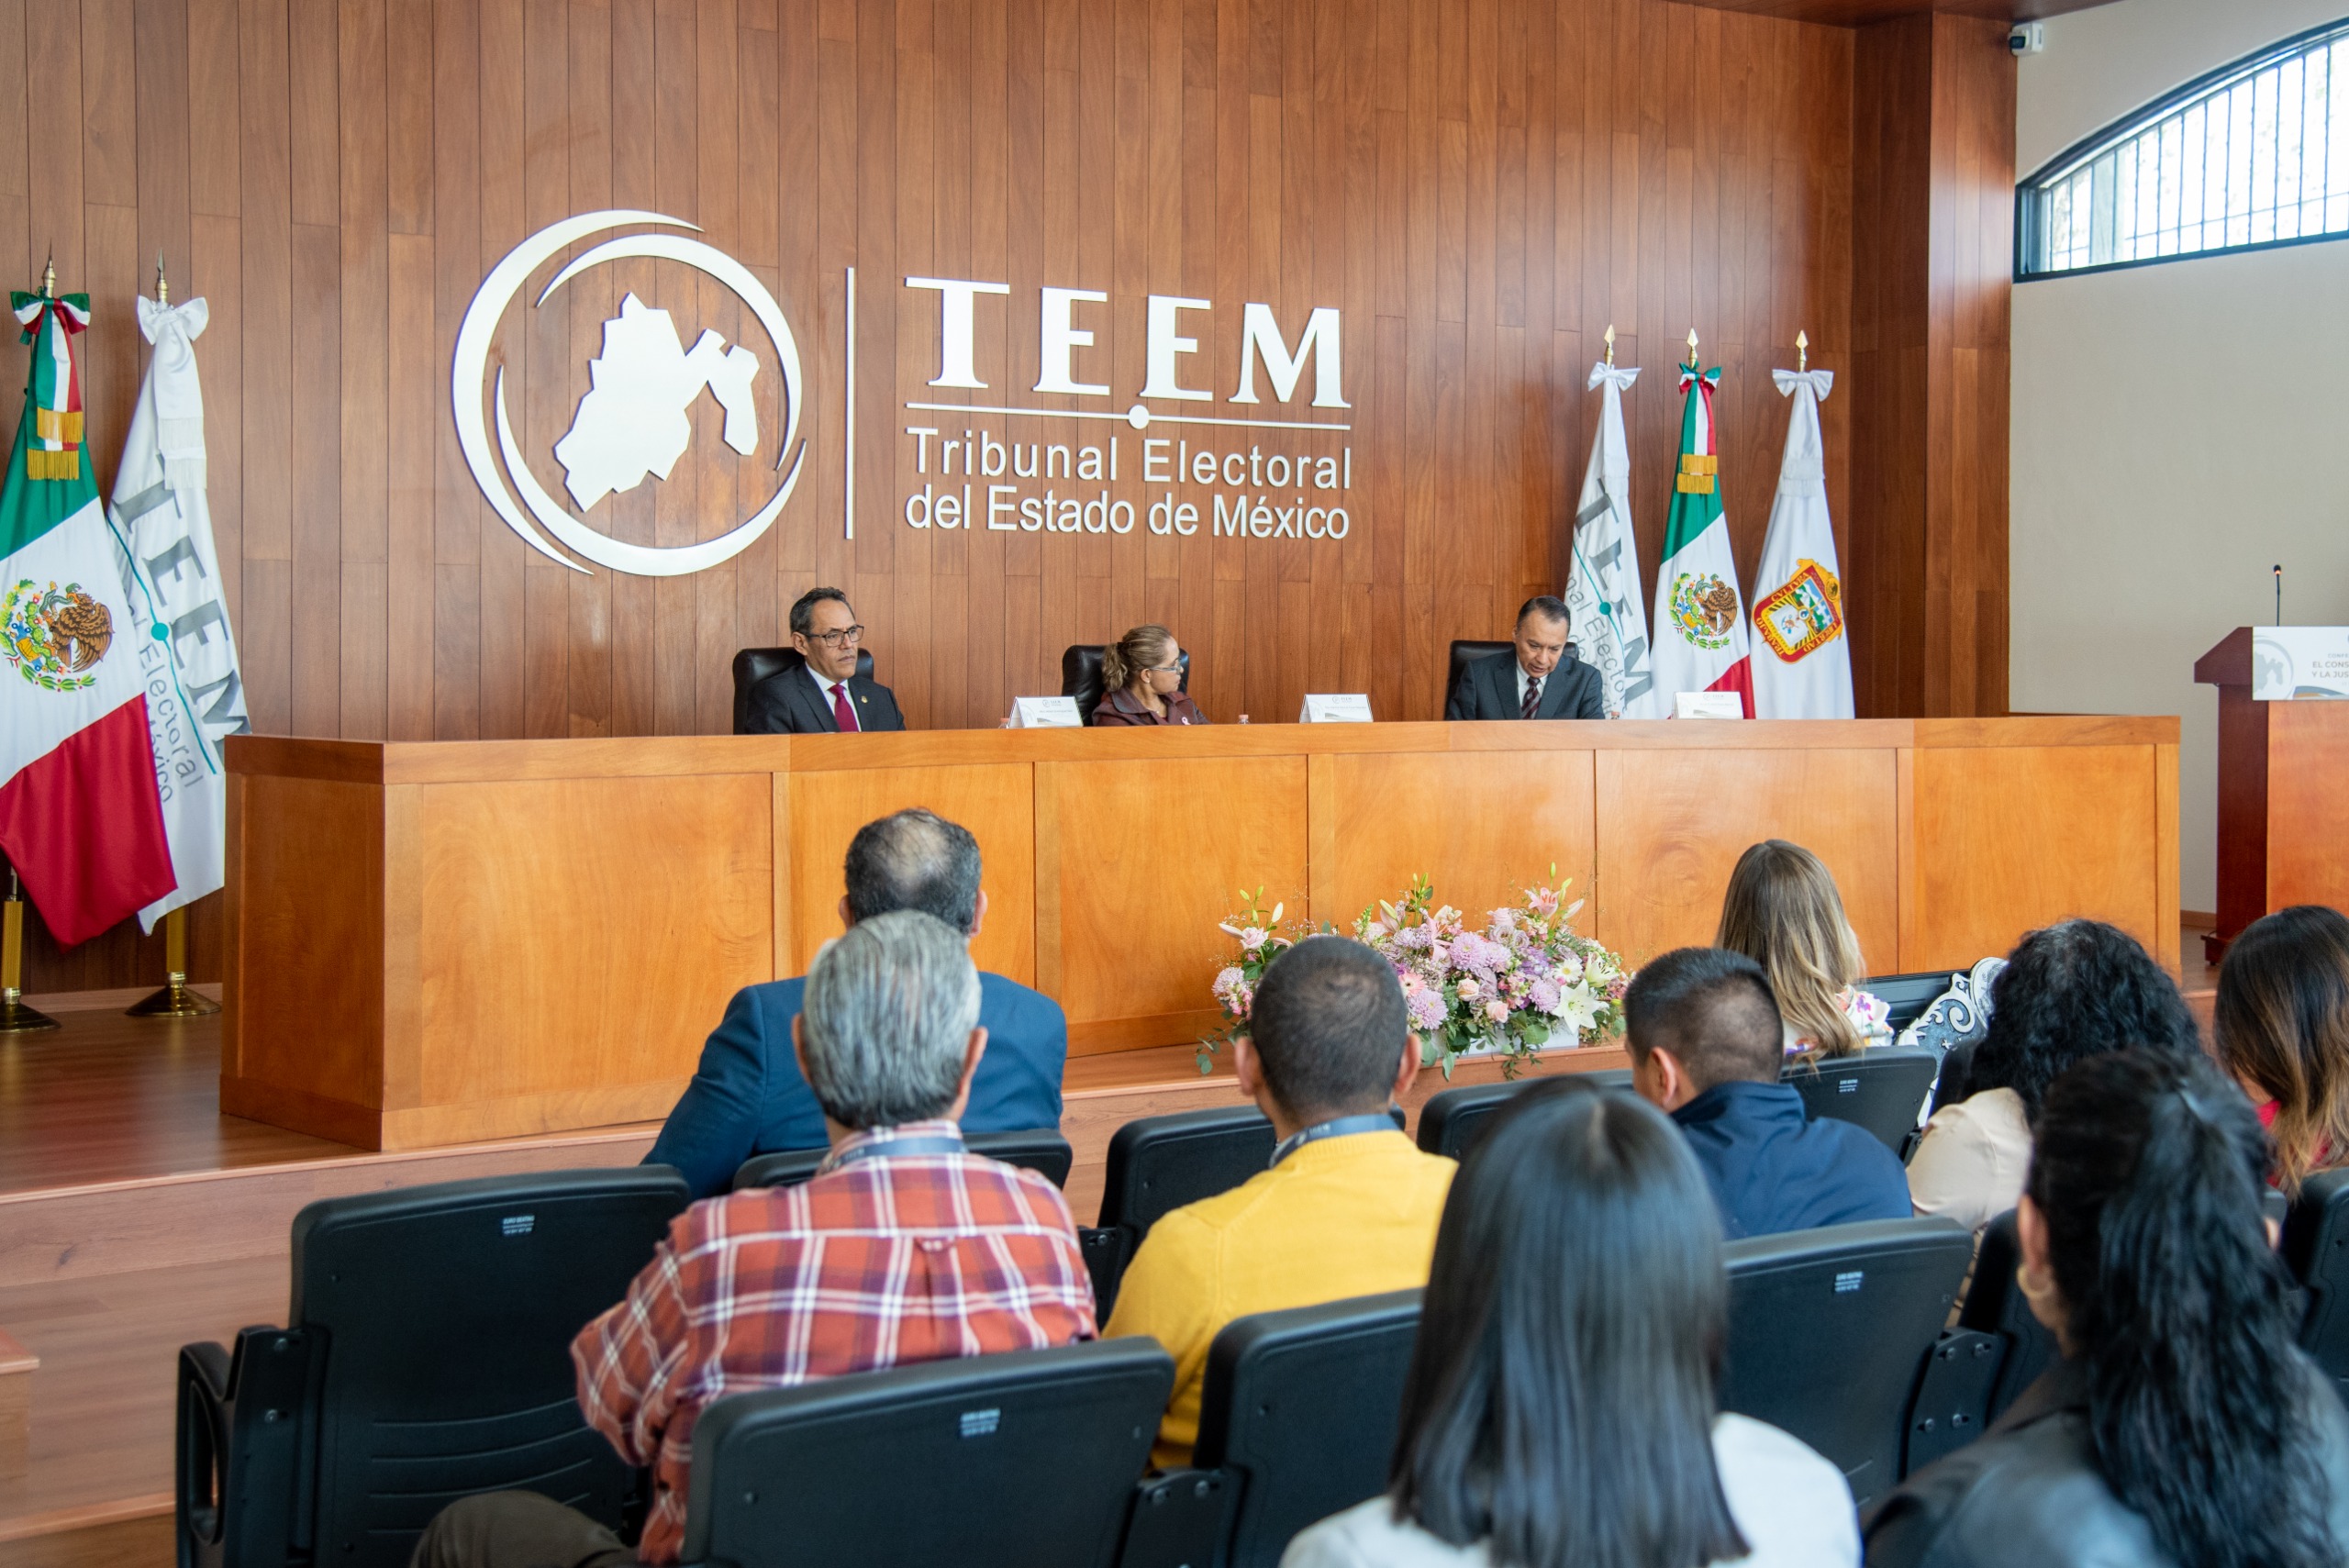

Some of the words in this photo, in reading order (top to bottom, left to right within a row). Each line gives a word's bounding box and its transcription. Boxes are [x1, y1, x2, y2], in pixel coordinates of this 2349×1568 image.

[905, 277, 1352, 409] TEEM
[906, 427, 1118, 482] Tribunal
[1143, 438, 1352, 490] Electoral
[905, 484, 971, 530] del
[986, 485, 1136, 534] Estado
[1148, 492, 1199, 536] de
[1213, 493, 1351, 539] México
[139, 641, 204, 788] Electoral
